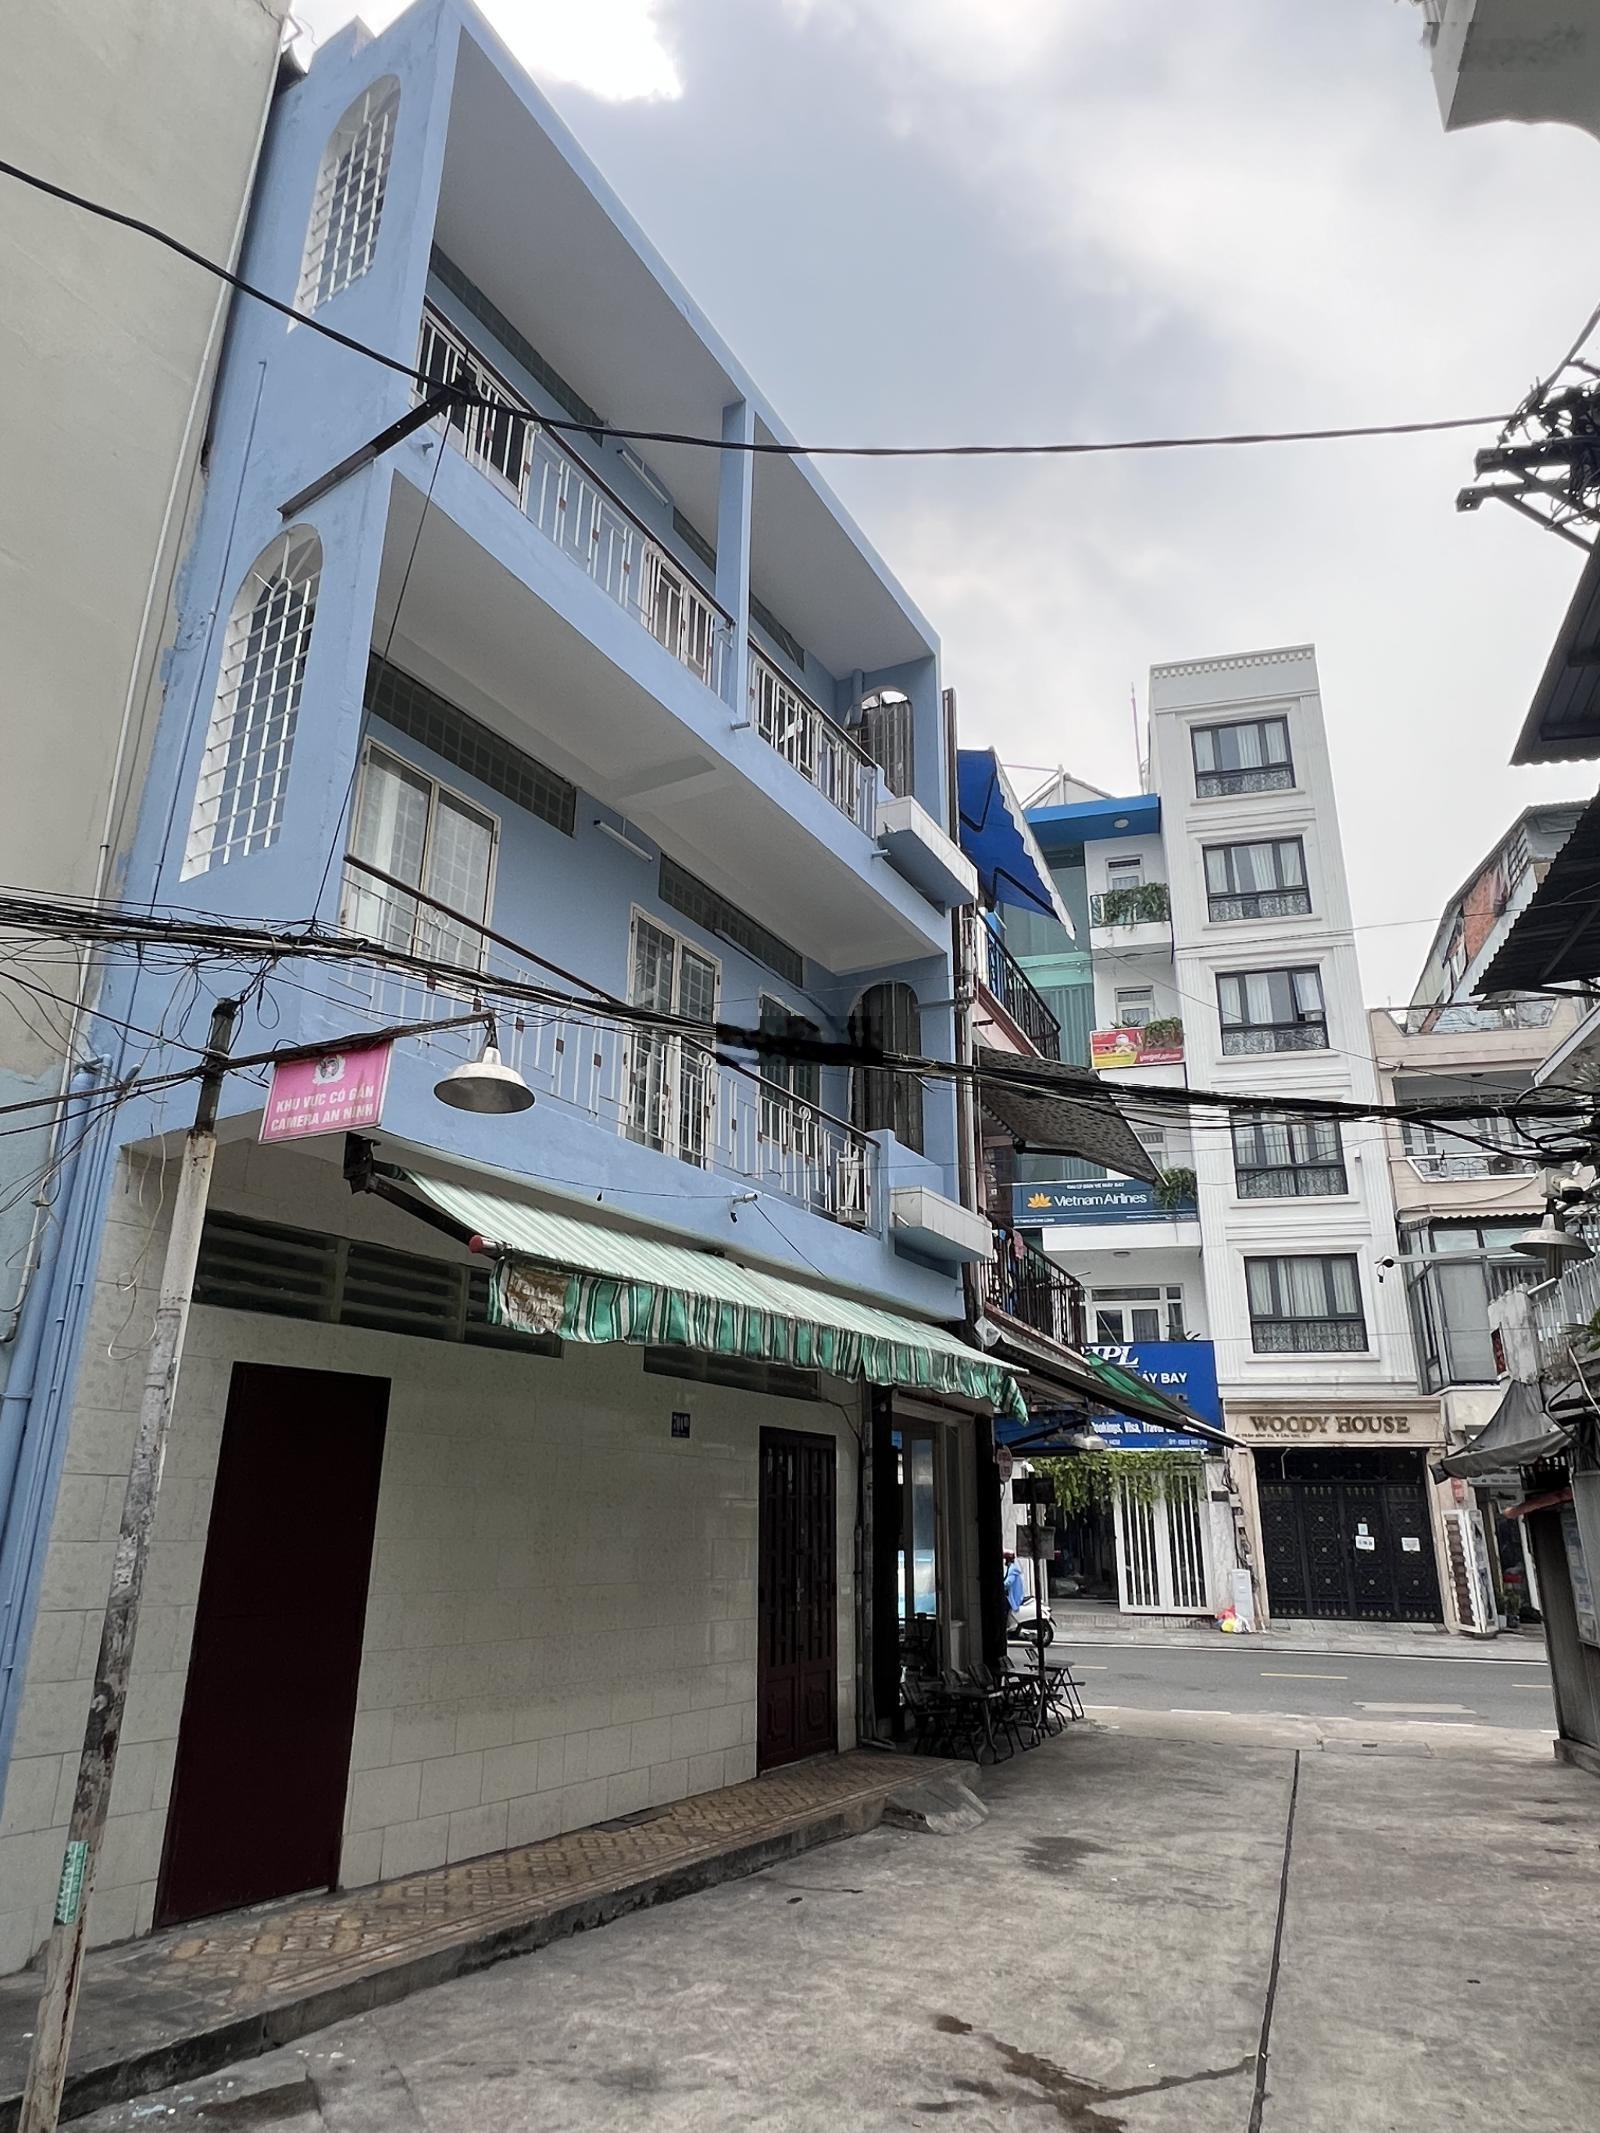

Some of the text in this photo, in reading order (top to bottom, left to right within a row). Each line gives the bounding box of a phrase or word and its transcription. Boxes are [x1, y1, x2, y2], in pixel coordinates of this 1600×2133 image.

[276, 1097, 300, 1113] KHU
[329, 1087, 346, 1104] CÓ
[271, 1103, 374, 1132] CAMERA AN NINH
[1053, 1192, 1147, 1207] Vietnam Airlines
[1160, 1372, 1187, 1384] BAY
[1250, 1416, 1410, 1433] WOODY HOUSE
